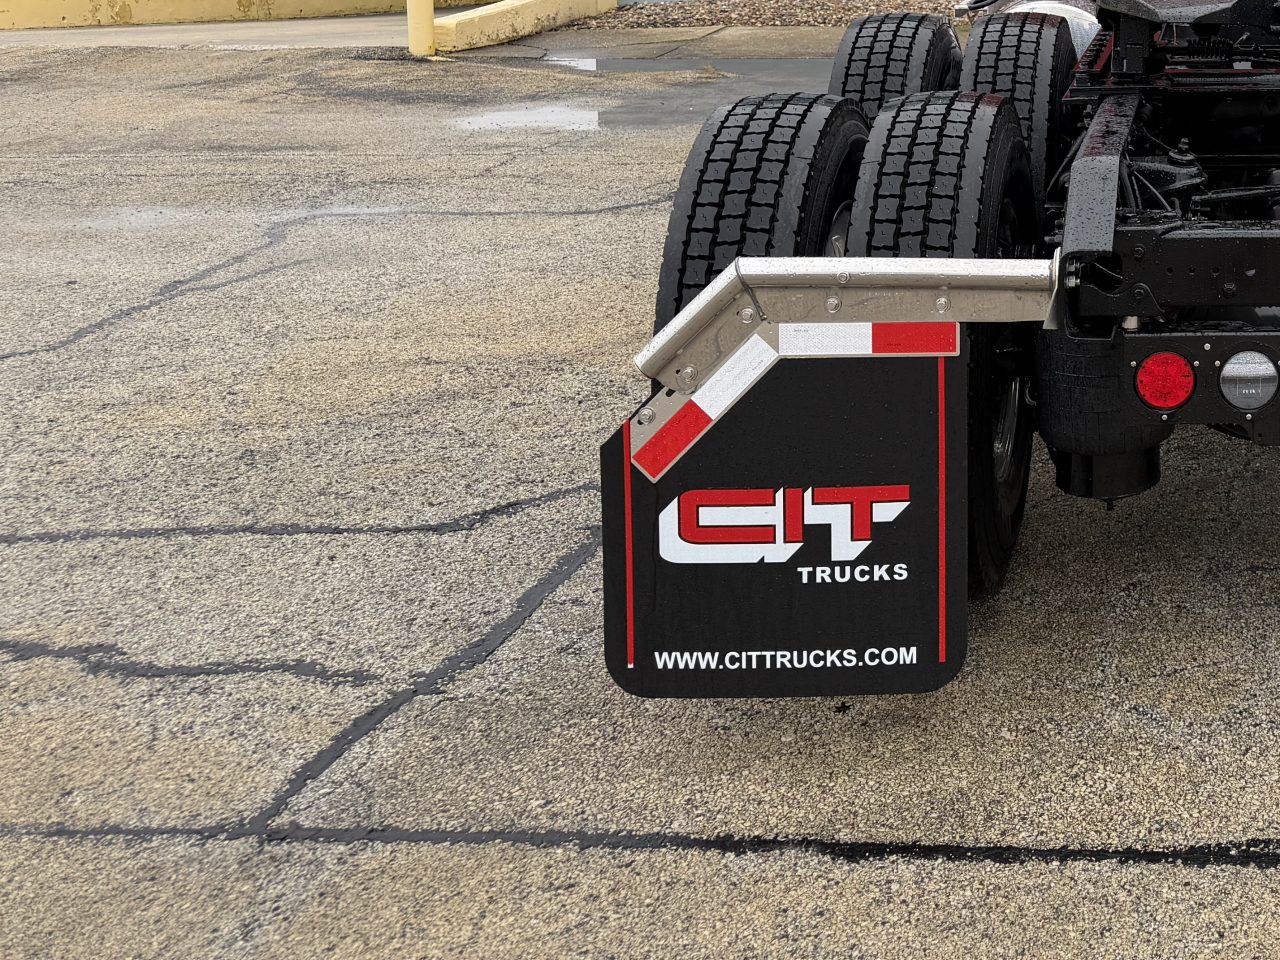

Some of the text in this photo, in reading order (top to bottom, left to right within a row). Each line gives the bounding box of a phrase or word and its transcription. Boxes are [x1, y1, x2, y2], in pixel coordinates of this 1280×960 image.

[658, 484, 911, 564] CIT
[796, 563, 909, 584] TRUCKS
[653, 646, 917, 670] WWW.CITTRUCKS.COM
